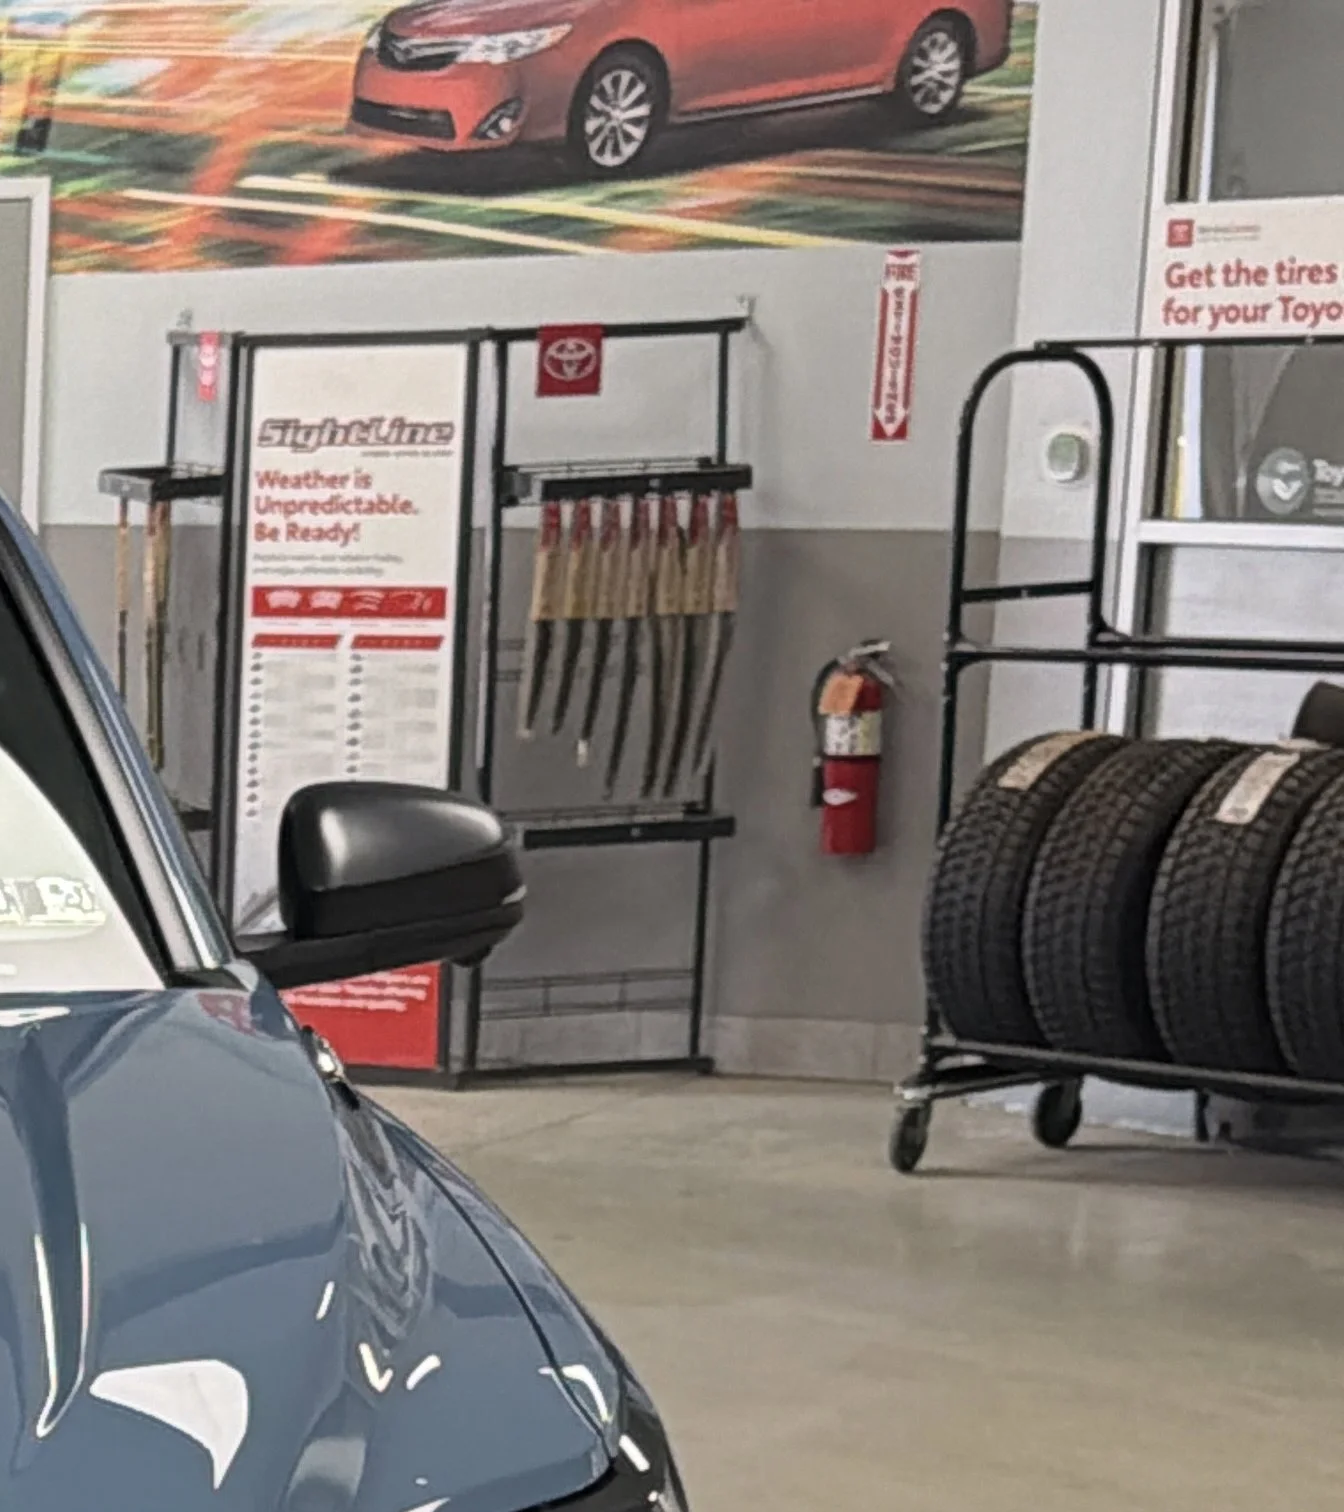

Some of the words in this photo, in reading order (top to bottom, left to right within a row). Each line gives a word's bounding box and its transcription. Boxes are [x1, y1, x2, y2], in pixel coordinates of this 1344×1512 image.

[885, 263, 917, 281] FIRE
[1165, 261, 1215, 289] Get
[1223, 257, 1269, 287] the
[1275, 256, 1338, 285] tires
[1162, 296, 1203, 326] for
[1208, 301, 1272, 331] your
[255, 469, 349, 490] Weather
[353, 467, 373, 489] is
[254, 494, 421, 518] Unpredictable.
[253, 522, 279, 542] Be
[285, 521, 362, 547] Ready!
